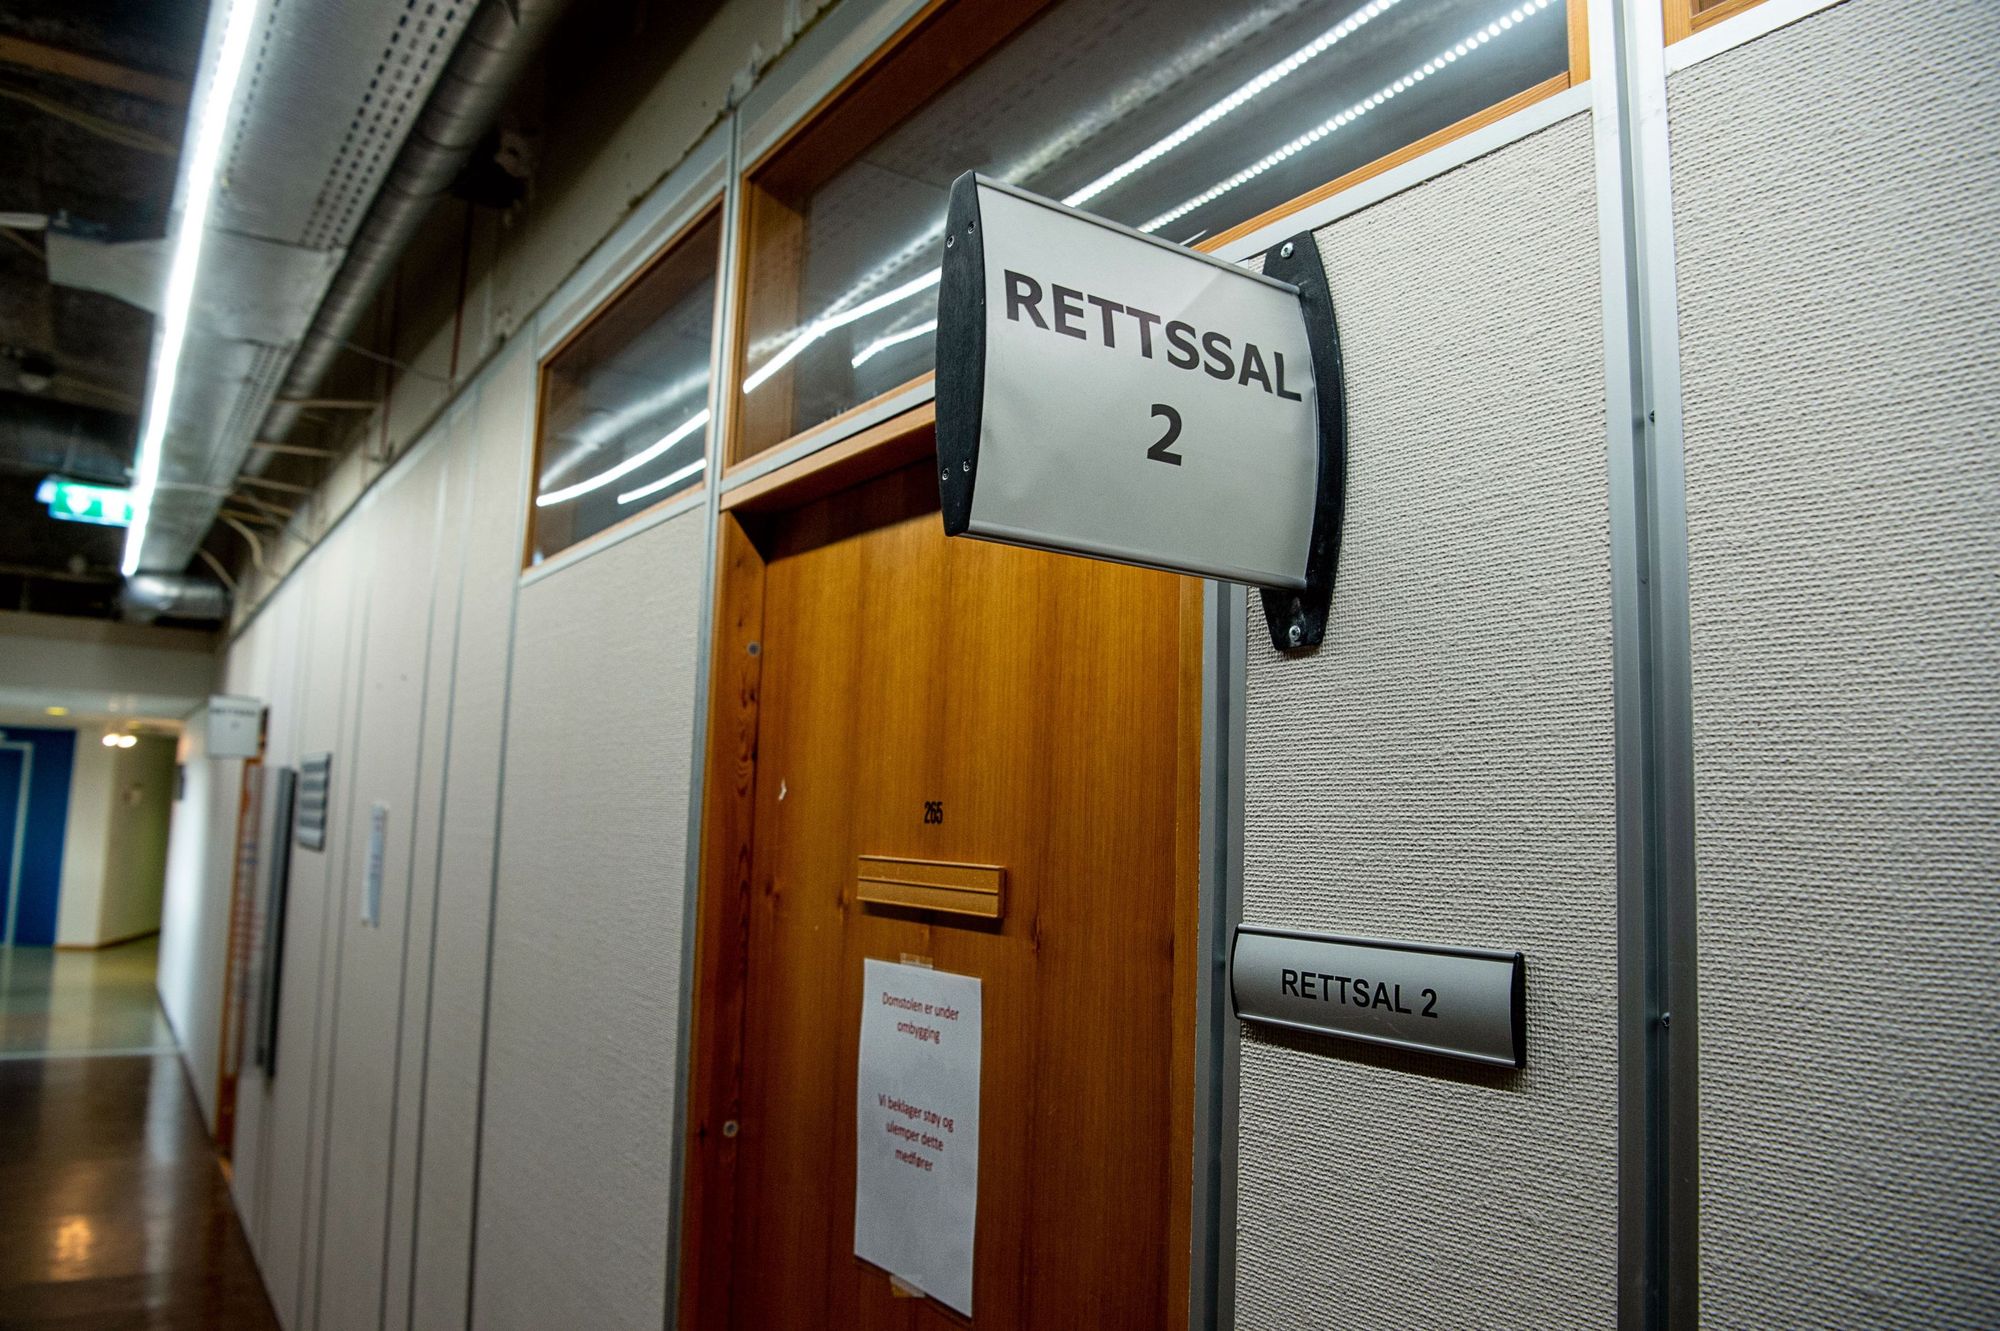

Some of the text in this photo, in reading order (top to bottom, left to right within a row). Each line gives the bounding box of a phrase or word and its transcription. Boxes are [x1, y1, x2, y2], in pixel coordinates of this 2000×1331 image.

[1004, 269, 1302, 402] RETTSSAL
[1146, 403, 1182, 466] 2
[924, 801, 943, 824] 265
[882, 992, 959, 1020] Domstolen er under
[1281, 969, 1438, 1018] RETTSAL 2
[897, 1021, 941, 1044] ombygging
[878, 1093, 954, 1133] Vi beklager støy og
[886, 1120, 944, 1151] ulemper dette
[895, 1148, 934, 1171] medfører
